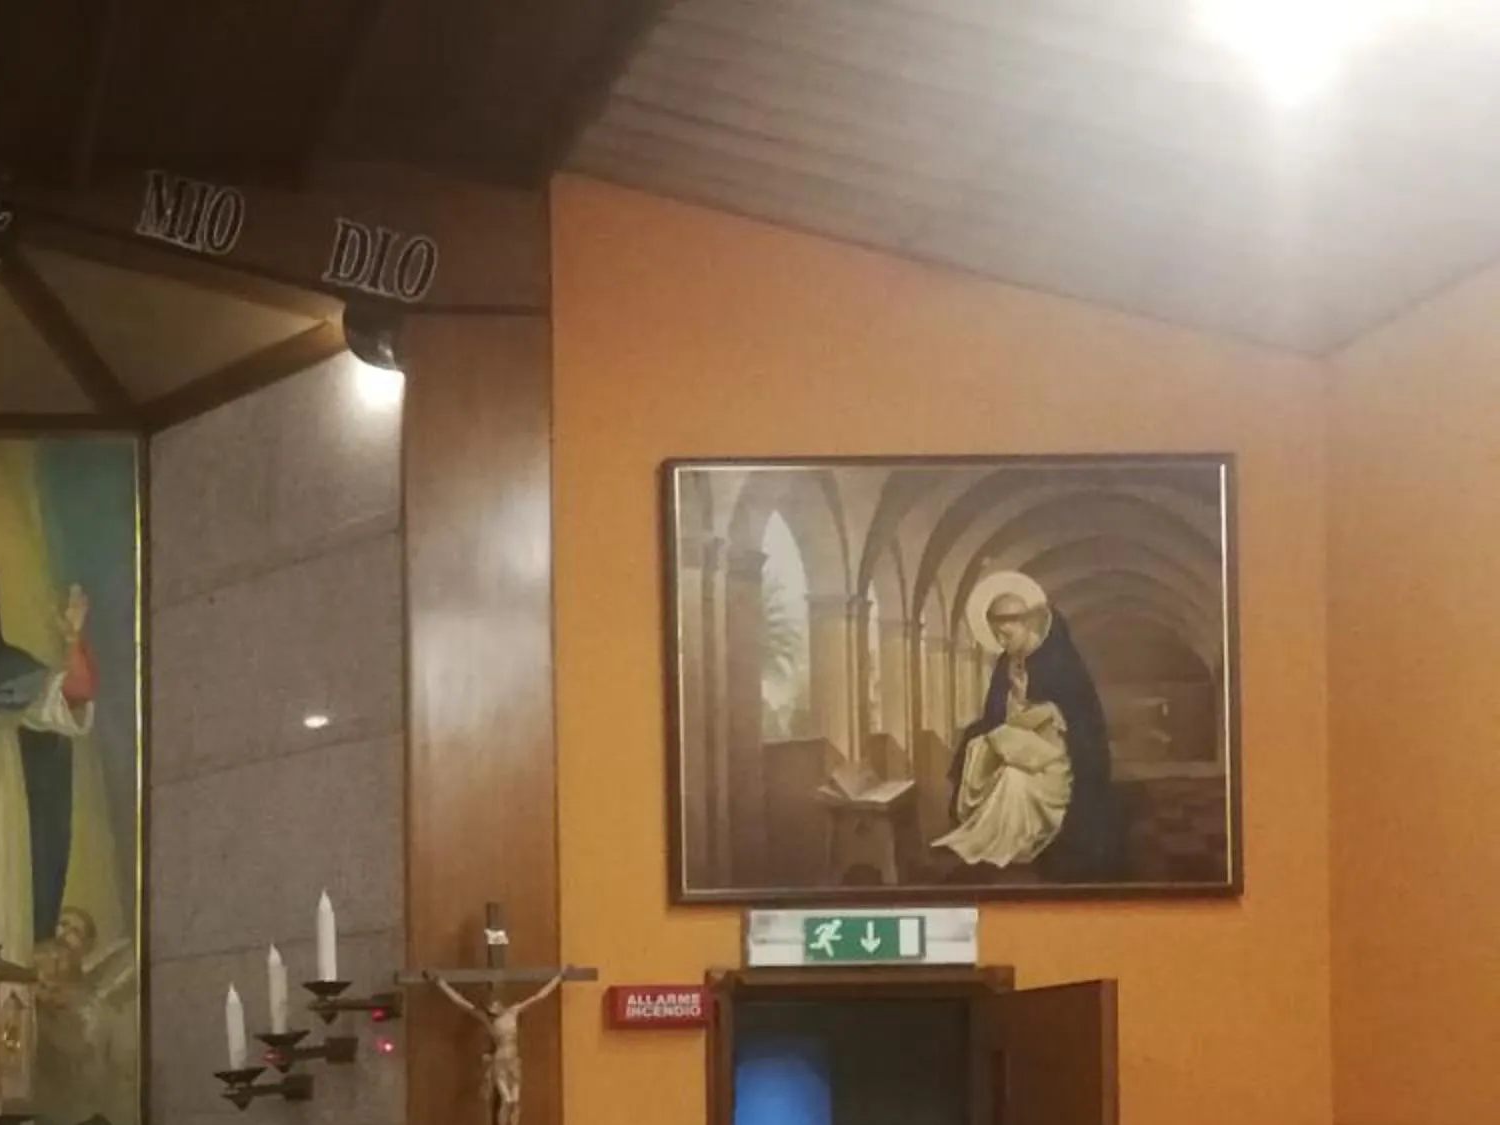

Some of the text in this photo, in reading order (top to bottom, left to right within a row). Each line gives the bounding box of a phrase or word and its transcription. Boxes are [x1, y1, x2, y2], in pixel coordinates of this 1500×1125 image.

[135, 169, 245, 255] MIO
[320, 217, 439, 303] DIO
[627, 993, 701, 1005] ALLARME
[626, 1005, 702, 1018] INCENDIO
